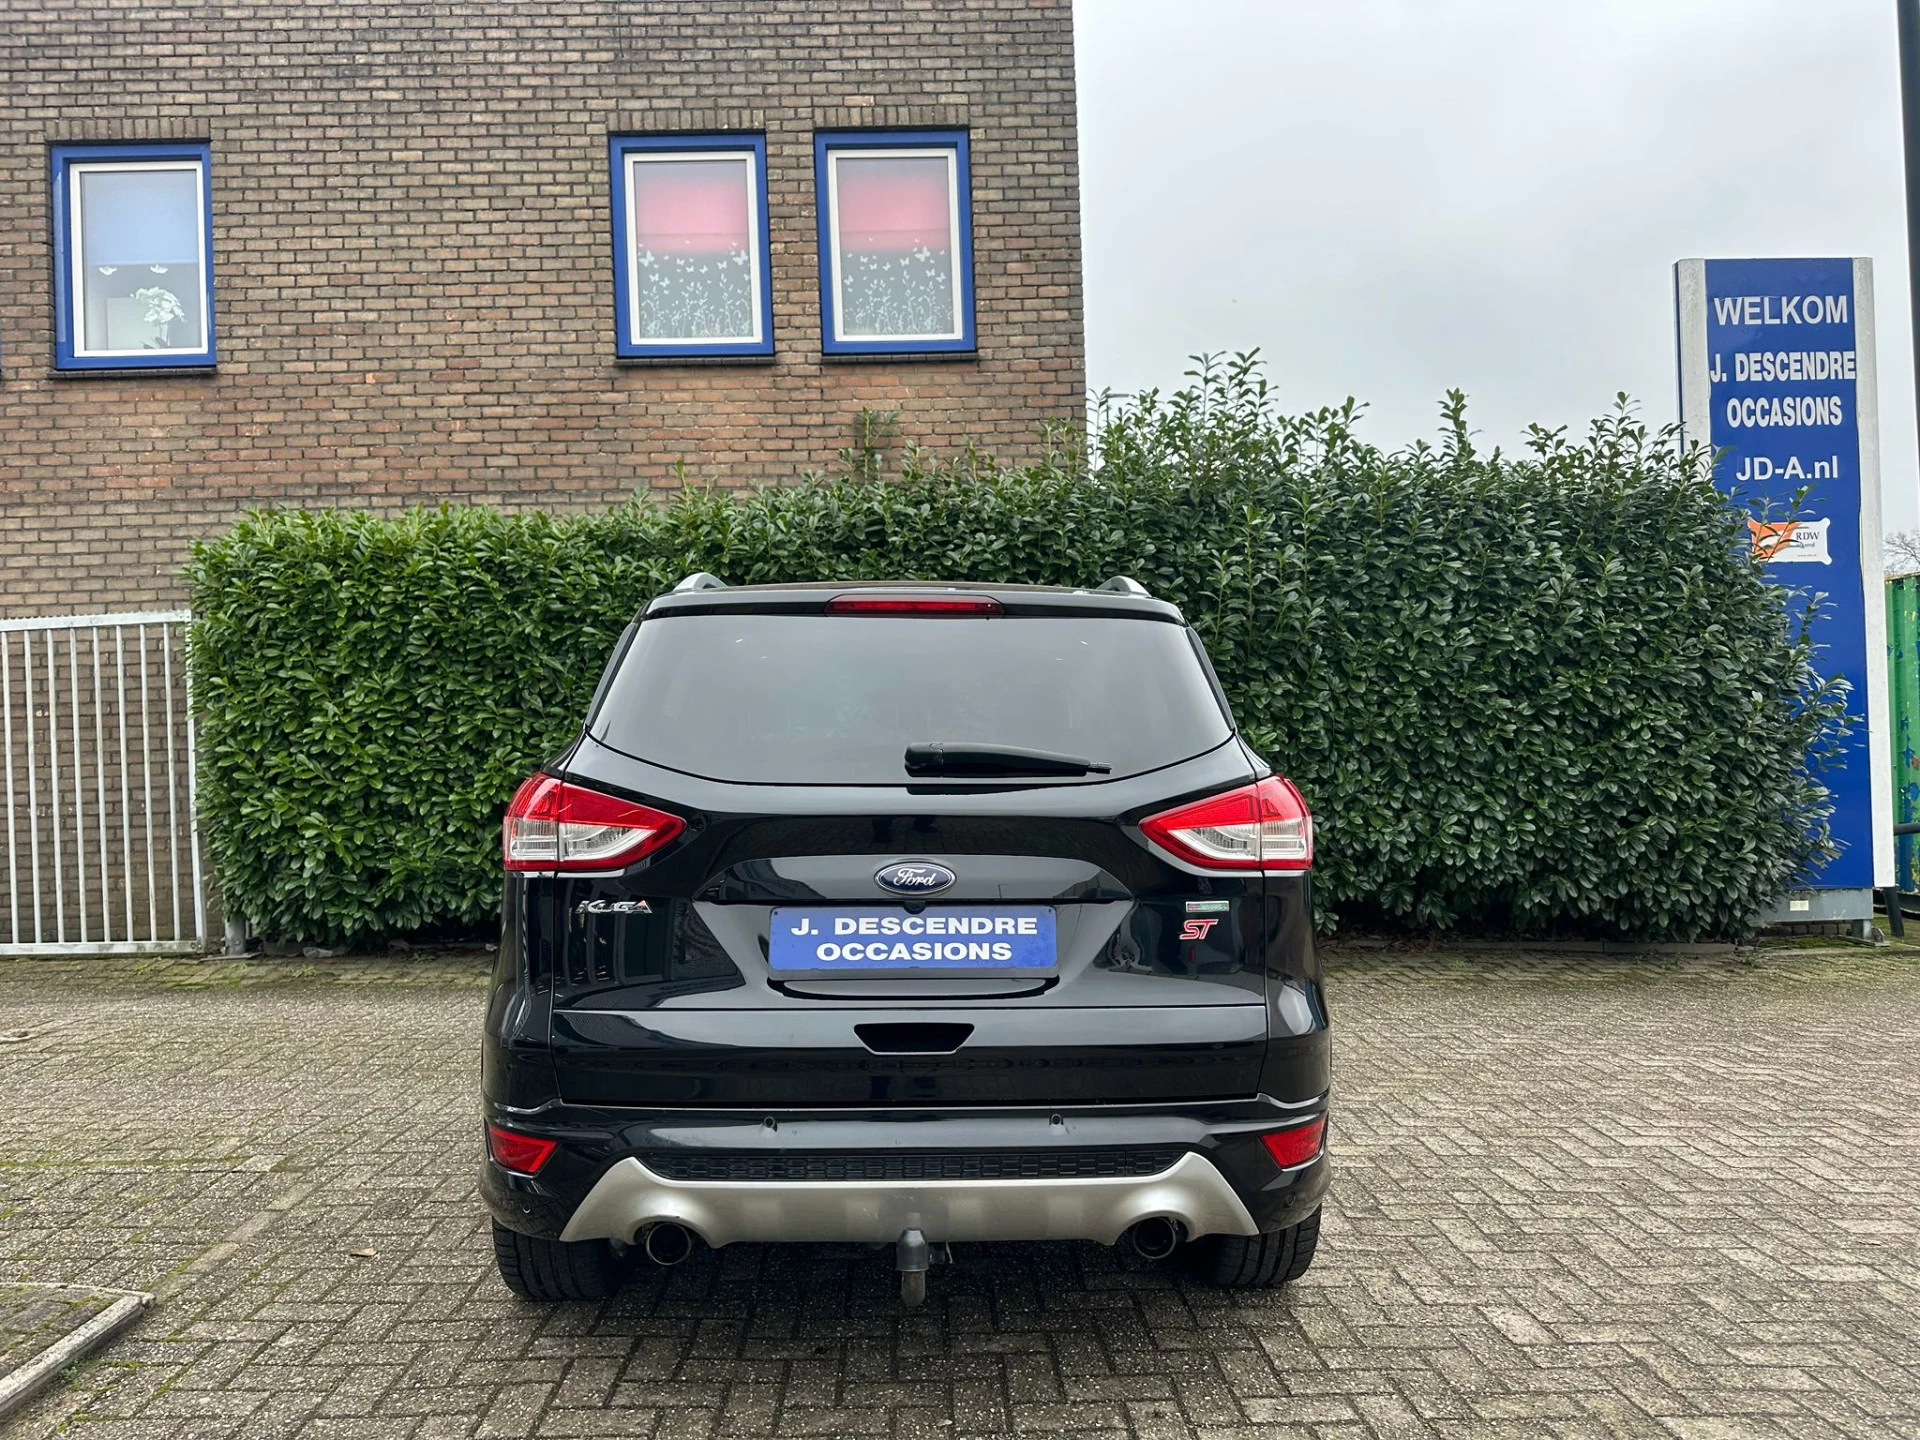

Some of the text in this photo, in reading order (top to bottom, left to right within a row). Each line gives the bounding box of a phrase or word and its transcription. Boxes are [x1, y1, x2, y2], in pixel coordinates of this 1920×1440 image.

[1713, 295, 1848, 326] WELKOM
[1709, 350, 1857, 383] J. DESCENDRE
[1726, 396, 1842, 428] OCCASIONS
[1735, 455, 1839, 481] JD-A.nl
[1796, 531, 1819, 540] RDW
[893, 868, 937, 886] Ford
[791, 917, 1038, 936] J. DESCENDRE
[1179, 919, 1219, 940] ST
[816, 942, 1013, 961] OCCASIONS
